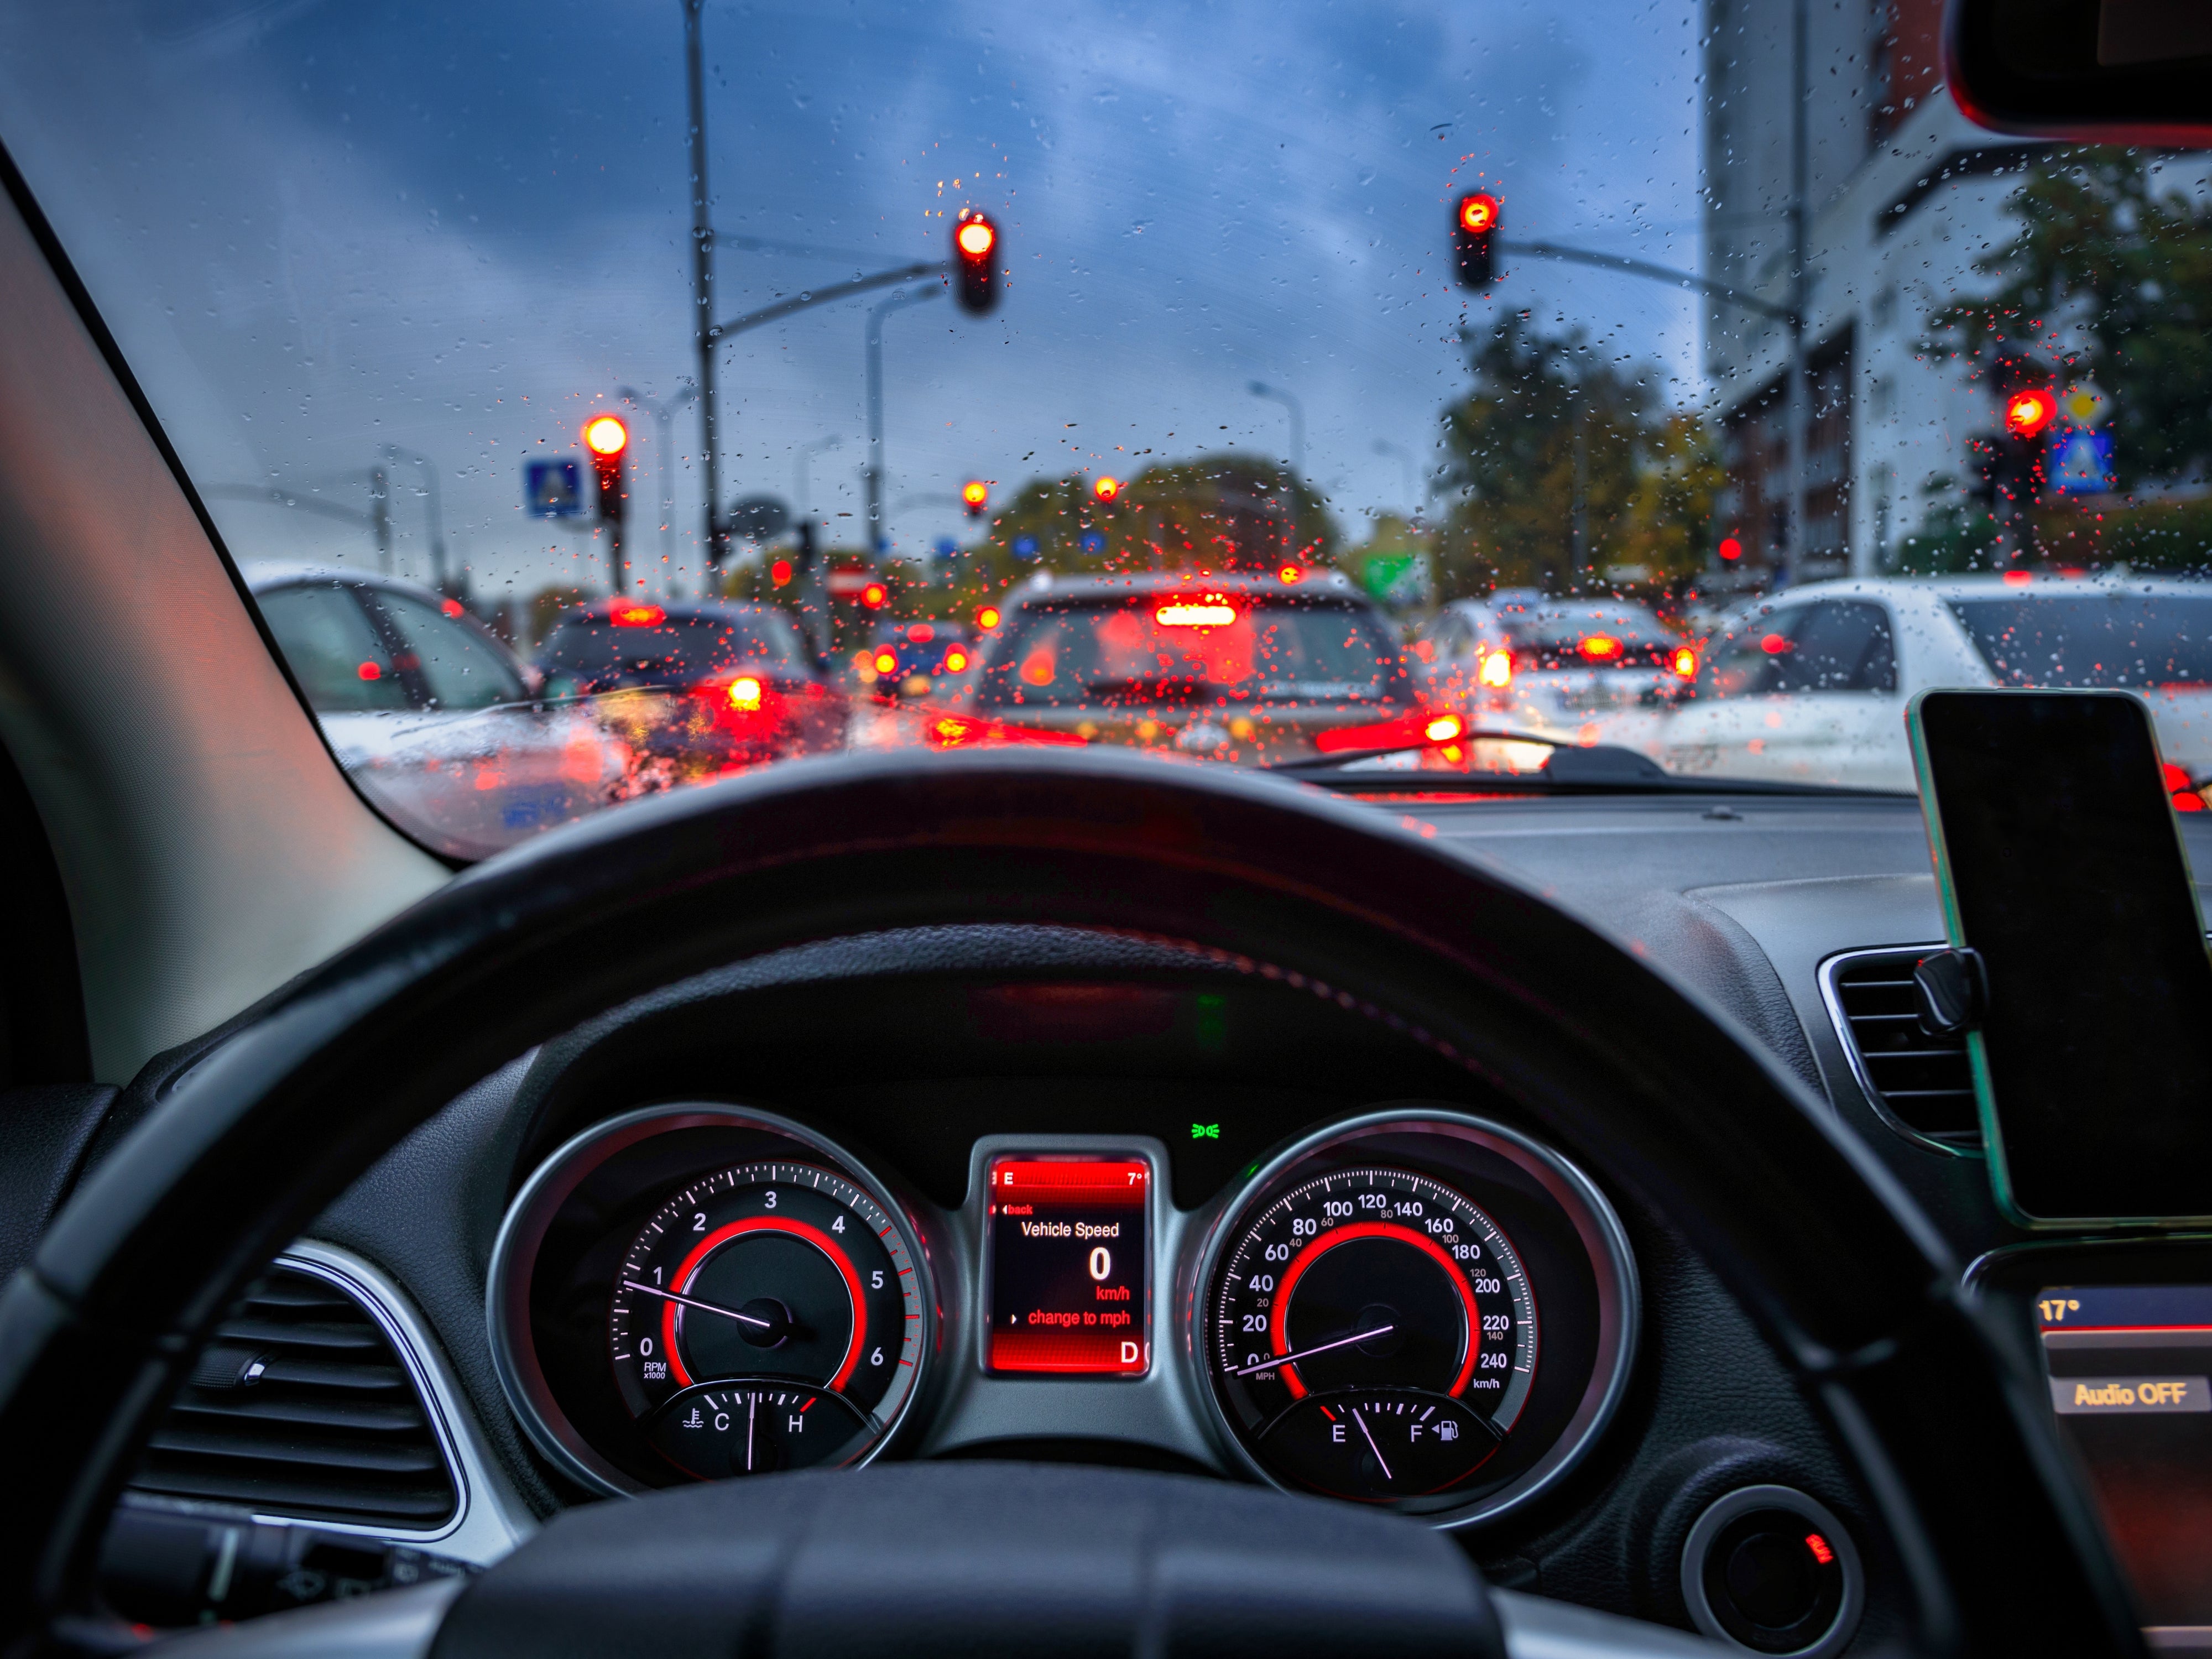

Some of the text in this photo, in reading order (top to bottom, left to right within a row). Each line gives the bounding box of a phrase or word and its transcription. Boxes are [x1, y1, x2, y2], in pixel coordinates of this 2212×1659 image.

[1004, 1172, 1013, 1185] E
[1128, 1173, 1142, 1185] 7°
[765, 1191, 776, 1208] 3
[1358, 1194, 1386, 1208] 120
[1008, 1204, 1032, 1215] back
[1323, 1202, 1353, 1216] 100
[1381, 1209, 1393, 1218] 80
[1394, 1202, 1422, 1216] 140
[693, 1213, 706, 1230] 2
[832, 1216, 845, 1233] 4
[1293, 1219, 1316, 1235] 80
[1321, 1218, 1333, 1226] 60
[1425, 1218, 1453, 1233] 160
[1022, 1222, 1119, 1239] Vehicle Speed
[1290, 1238, 1302, 1246] 40
[1442, 1234, 1459, 1243] 100
[1265, 1244, 1288, 1260] 60
[1452, 1245, 1480, 1259] 180
[1091, 1247, 1110, 1280] 0
[654, 1267, 661, 1284] 1
[872, 1271, 883, 1288] 5
[1470, 1269, 1486, 1277] 120
[1249, 1275, 1273, 1291] 40
[1475, 1279, 1500, 1293] 200
[1097, 1286, 1129, 1301] km/h
[1258, 1298, 1269, 1307] 20
[1029, 1310, 1130, 1328] change to mph
[1243, 1315, 1266, 1332] 20
[1484, 1316, 1509, 1330] 220
[1487, 1332, 1503, 1340] 140
[640, 1338, 653, 1356] 0
[1121, 1342, 1138, 1363] D
[871, 1348, 883, 1365] 6
[1481, 1353, 1506, 1368] 240
[644, 1362, 666, 1371] RPM
[1474, 1379, 1499, 1389] km/h
[2074, 1383, 2187, 1406] Audio OFF
[715, 1413, 729, 1431] C
[789, 1415, 802, 1432] H
[1333, 1425, 1345, 1442] E
[1411, 1425, 1422, 1442] F
[1806, 1534, 1833, 1563] RUN
